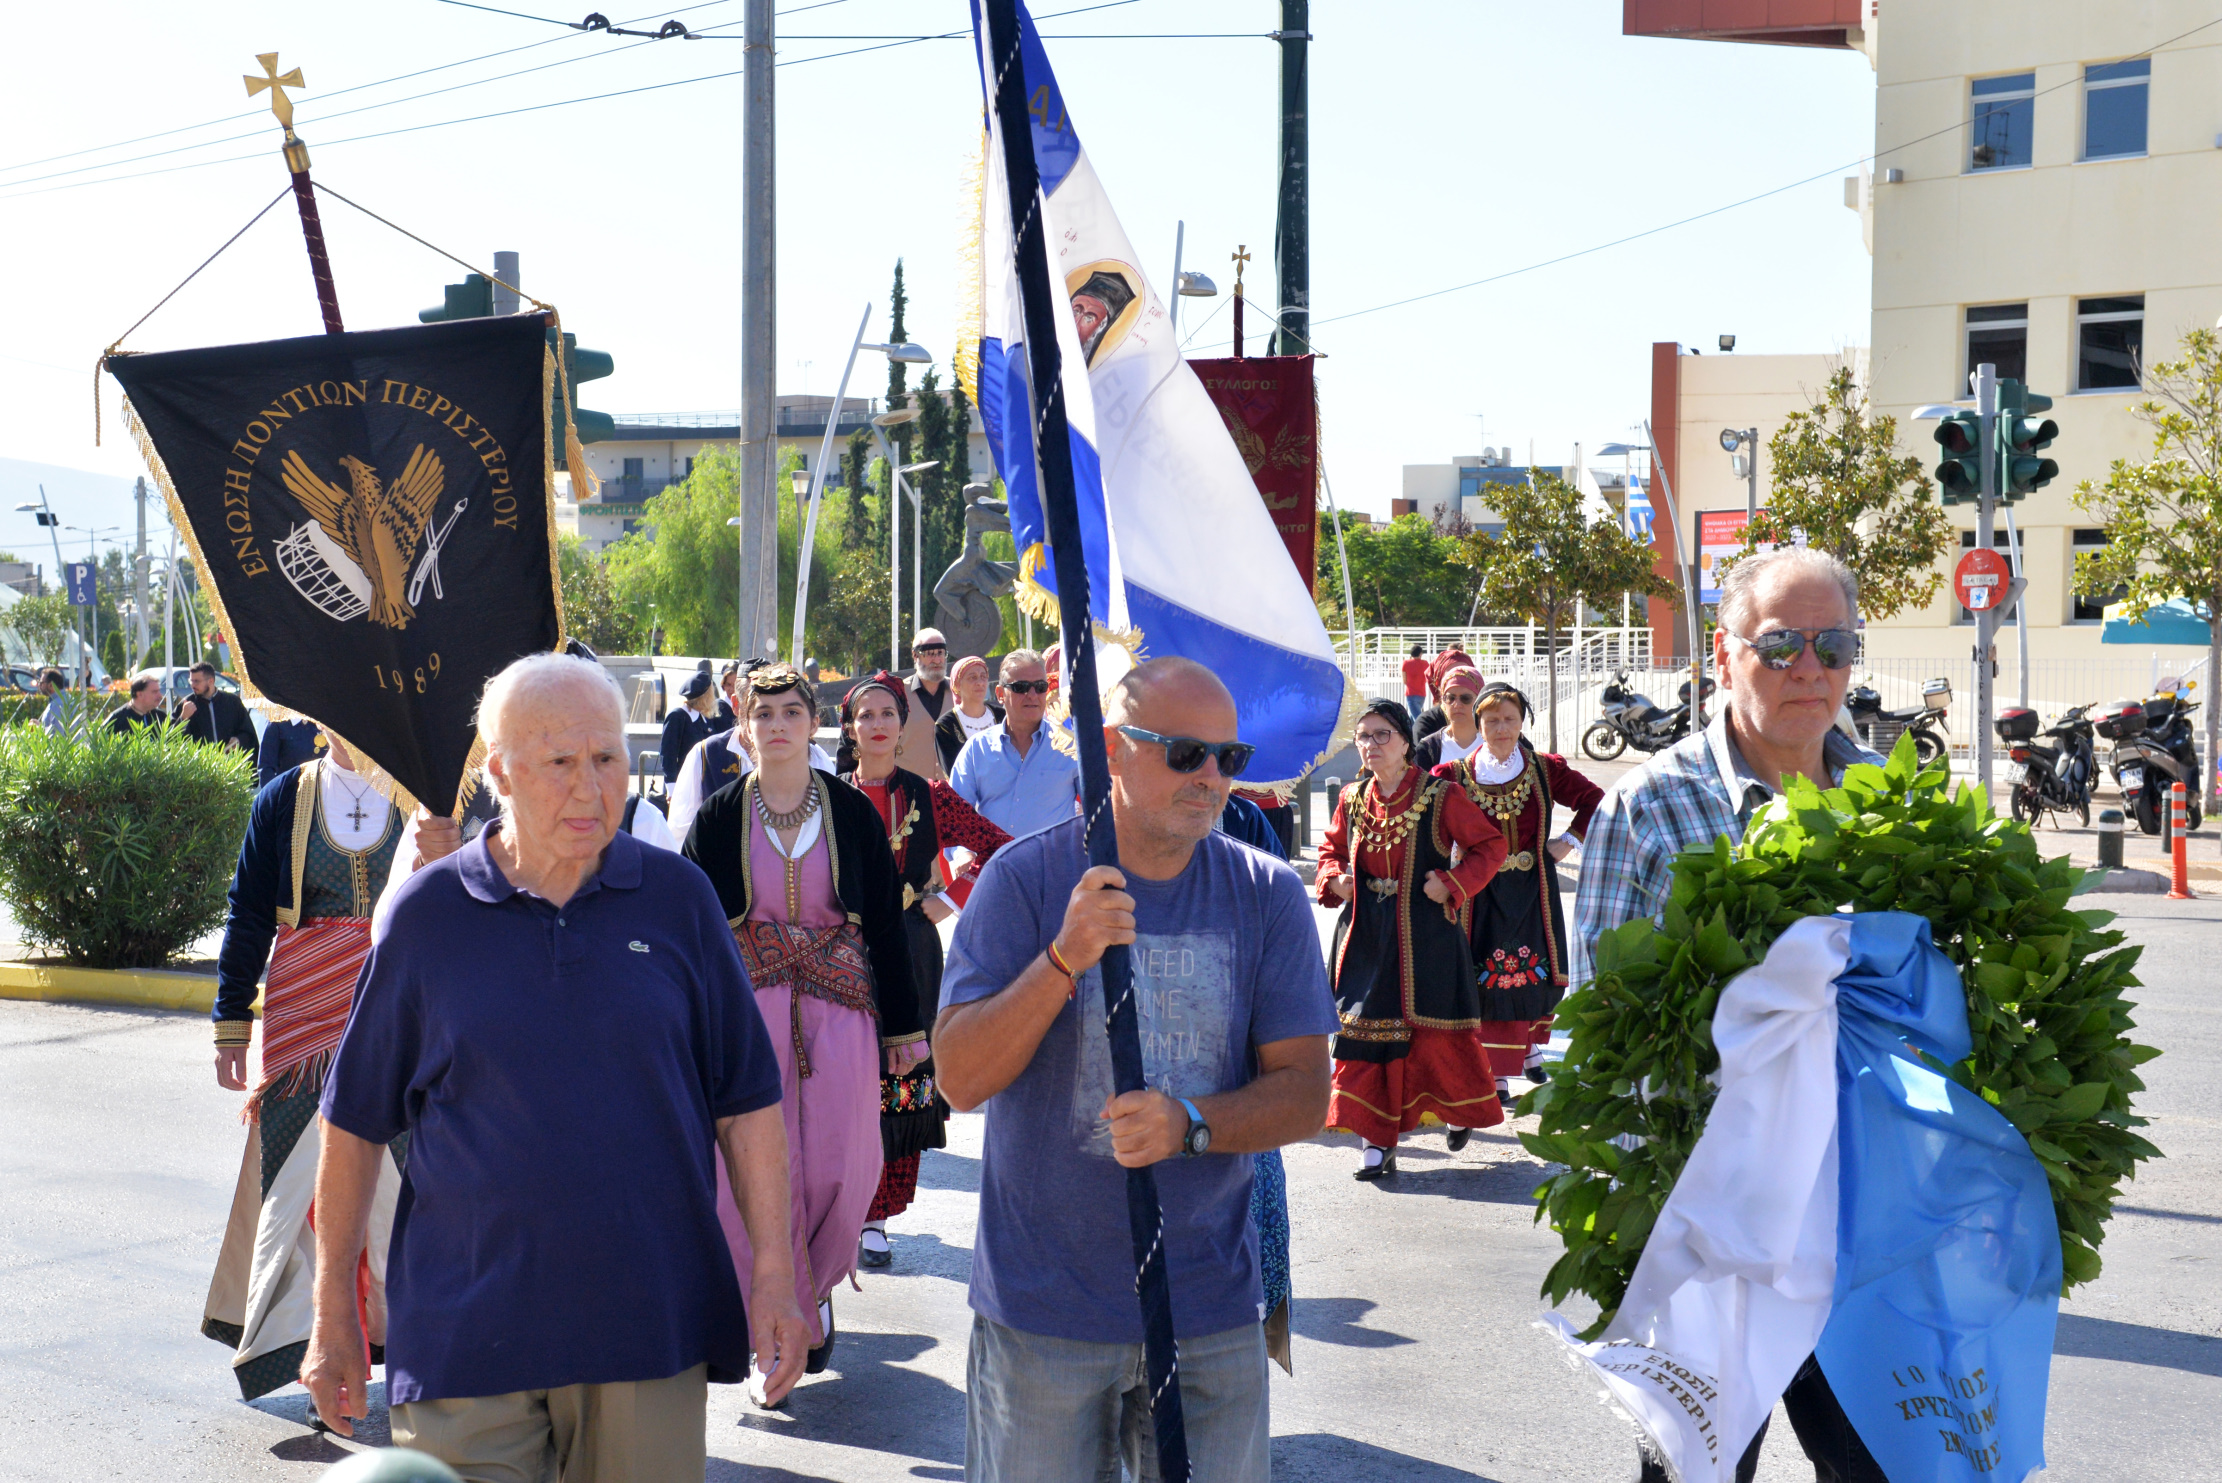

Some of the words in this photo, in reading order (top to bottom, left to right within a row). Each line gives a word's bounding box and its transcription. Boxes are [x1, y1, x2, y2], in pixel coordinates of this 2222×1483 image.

[1205, 378, 1279, 391] ΣΥΛΛΟΓΟΣ
[231, 379, 368, 465] ΠΟΝΤΙΩΝ
[381, 379, 518, 531] ΠΕΡΙΣΤΕΡΙΟΥ
[224, 467, 269, 578] ΕΝΩΣΗ
[579, 504, 648, 516] ΦΡΟΝΤΙΣΤΗ
[76, 565, 88, 585] P
[373, 652, 441, 693] 1989
[1644, 1354, 1718, 1402] ΕΝΩΣΗ
